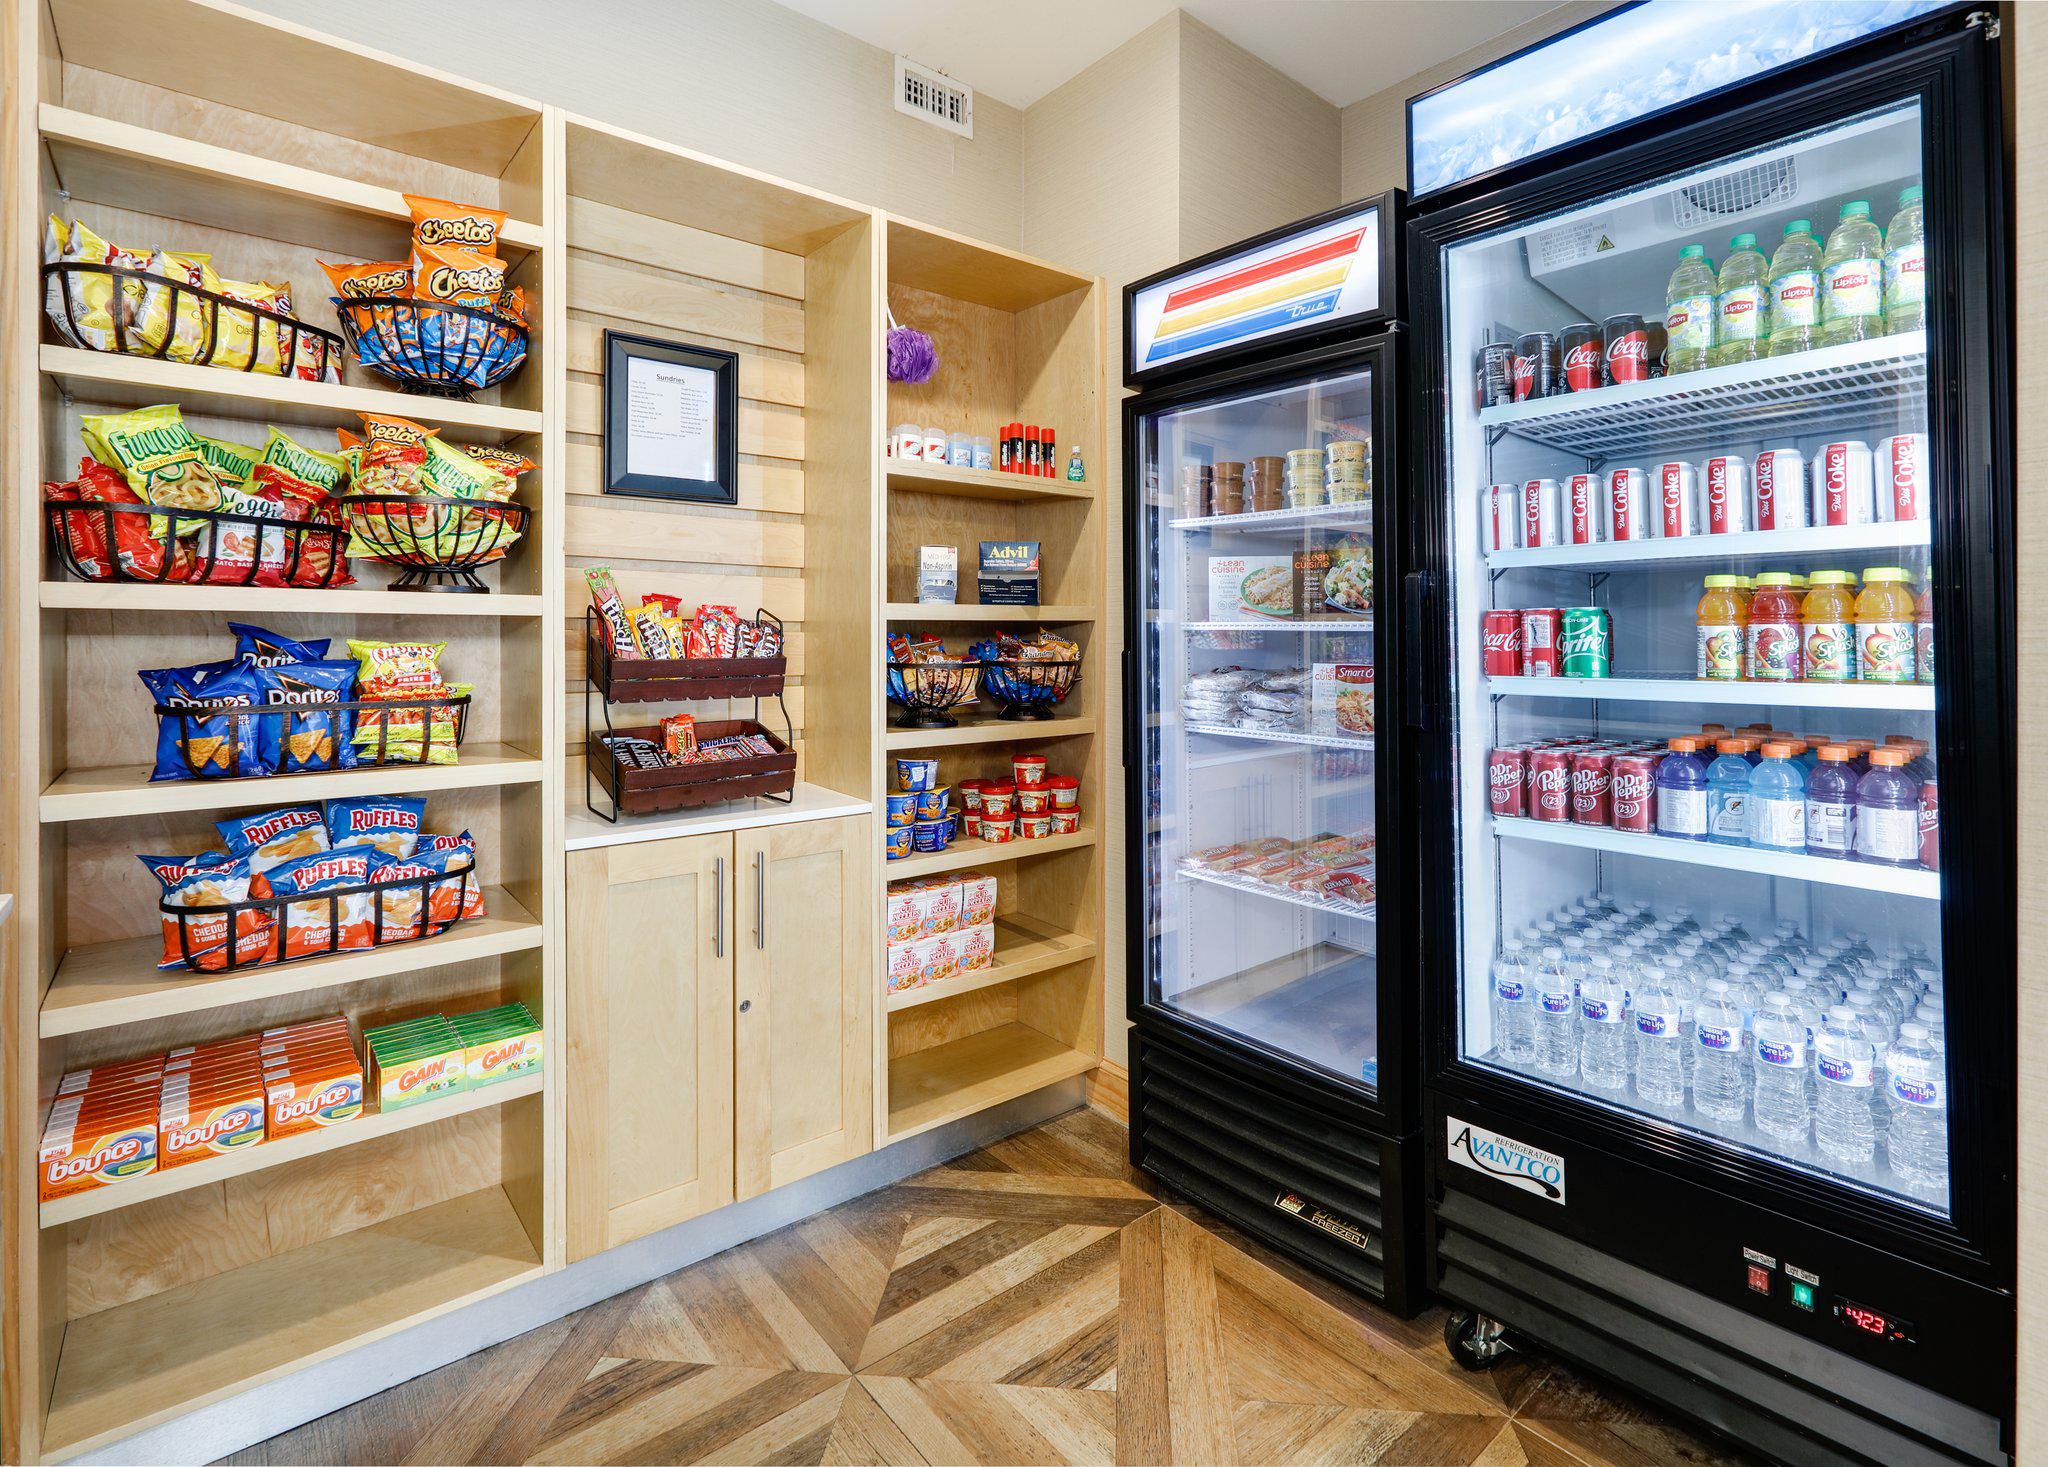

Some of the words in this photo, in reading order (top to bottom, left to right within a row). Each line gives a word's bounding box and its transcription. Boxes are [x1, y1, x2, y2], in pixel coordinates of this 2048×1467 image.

[419, 217, 496, 246] Cheetos
[430, 266, 505, 299] Cheetos
[1783, 287, 1812, 299] Lipton
[1725, 302, 1752, 314] Lipton
[656, 373, 685, 384] Sundries
[468, 445, 524, 465] Cheetos
[1827, 452, 1847, 492] Coke
[1894, 444, 1915, 486] Coke
[1709, 465, 1725, 504] Coke
[1757, 461, 1772, 500] Coke
[1613, 478, 1628, 513] Coke
[1664, 472, 1680, 508] Coke
[1526, 488, 1539, 521] Coke
[1572, 483, 1587, 517] Coke
[1831, 493, 1841, 512] Diet
[1668, 509, 1677, 526] Diet
[1713, 504, 1722, 522] Diet
[1760, 500, 1770, 518] Diet
[1576, 517, 1584, 533] Diet
[1617, 514, 1626, 529] Diet
[989, 546, 1029, 558] Advil
[1309, 553, 1329, 561] Lean
[203, 558, 236, 568] TMATO,
[237, 561, 257, 570] BASI
[1782, 627, 1796, 640] V8
[1831, 626, 1847, 640] V8
[1893, 626, 1907, 640] V8
[1338, 668, 1364, 678] Smart
[268, 689, 341, 705] Doritos
[698, 735, 737, 750] SNICKERS
[1490, 766, 1522, 785] Pepper
[1497, 764, 1513, 775] Dr
[1553, 768, 1568, 779] Dr
[1580, 769, 1599, 781] Dr
[1572, 772, 1610, 793] Pepper
[1612, 776, 1653, 799] Pepper
[1625, 774, 1642, 786] Dr
[1549, 795, 1559, 805] 23
[1578, 798, 1588, 808] 23
[1619, 804, 1631, 814] 23
[243, 810, 322, 845] RUFFLES
[352, 809, 418, 831] RUFFLES
[292, 859, 368, 890] RUFFLES
[193, 922, 230, 937] CHEDDA
[382, 928, 414, 937] HEDDAR
[1511, 987, 1523, 996] Life
[1542, 997, 1556, 1007] Pure
[1557, 999, 1571, 1008] Life
[1582, 1002, 1595, 1013] Pure
[1595, 1007, 1608, 1017] Life
[1637, 1015, 1651, 1027] Pure
[1651, 1020, 1665, 1031] Life
[1699, 1030, 1717, 1041] Pure
[1717, 1034, 1730, 1045] Life
[482, 1040, 525, 1071] GAIN
[1760, 1044, 1778, 1056] Pure
[1778, 1049, 1793, 1060] Life
[399, 1058, 446, 1091] GAIN
[1820, 1058, 1836, 1071] Pure
[1836, 1065, 1852, 1077] Life
[1896, 1081, 1918, 1094] Pure
[1918, 1086, 1936, 1099] Life
[277, 1087, 348, 1122] bounce
[169, 1112, 247, 1151] bounce
[1451, 1127, 1561, 1188] AVANTCO
[1495, 1137, 1560, 1166] REFRIGERATION
[49, 1139, 139, 1182] bounce
[1312, 1215, 1360, 1244] FREEZER
